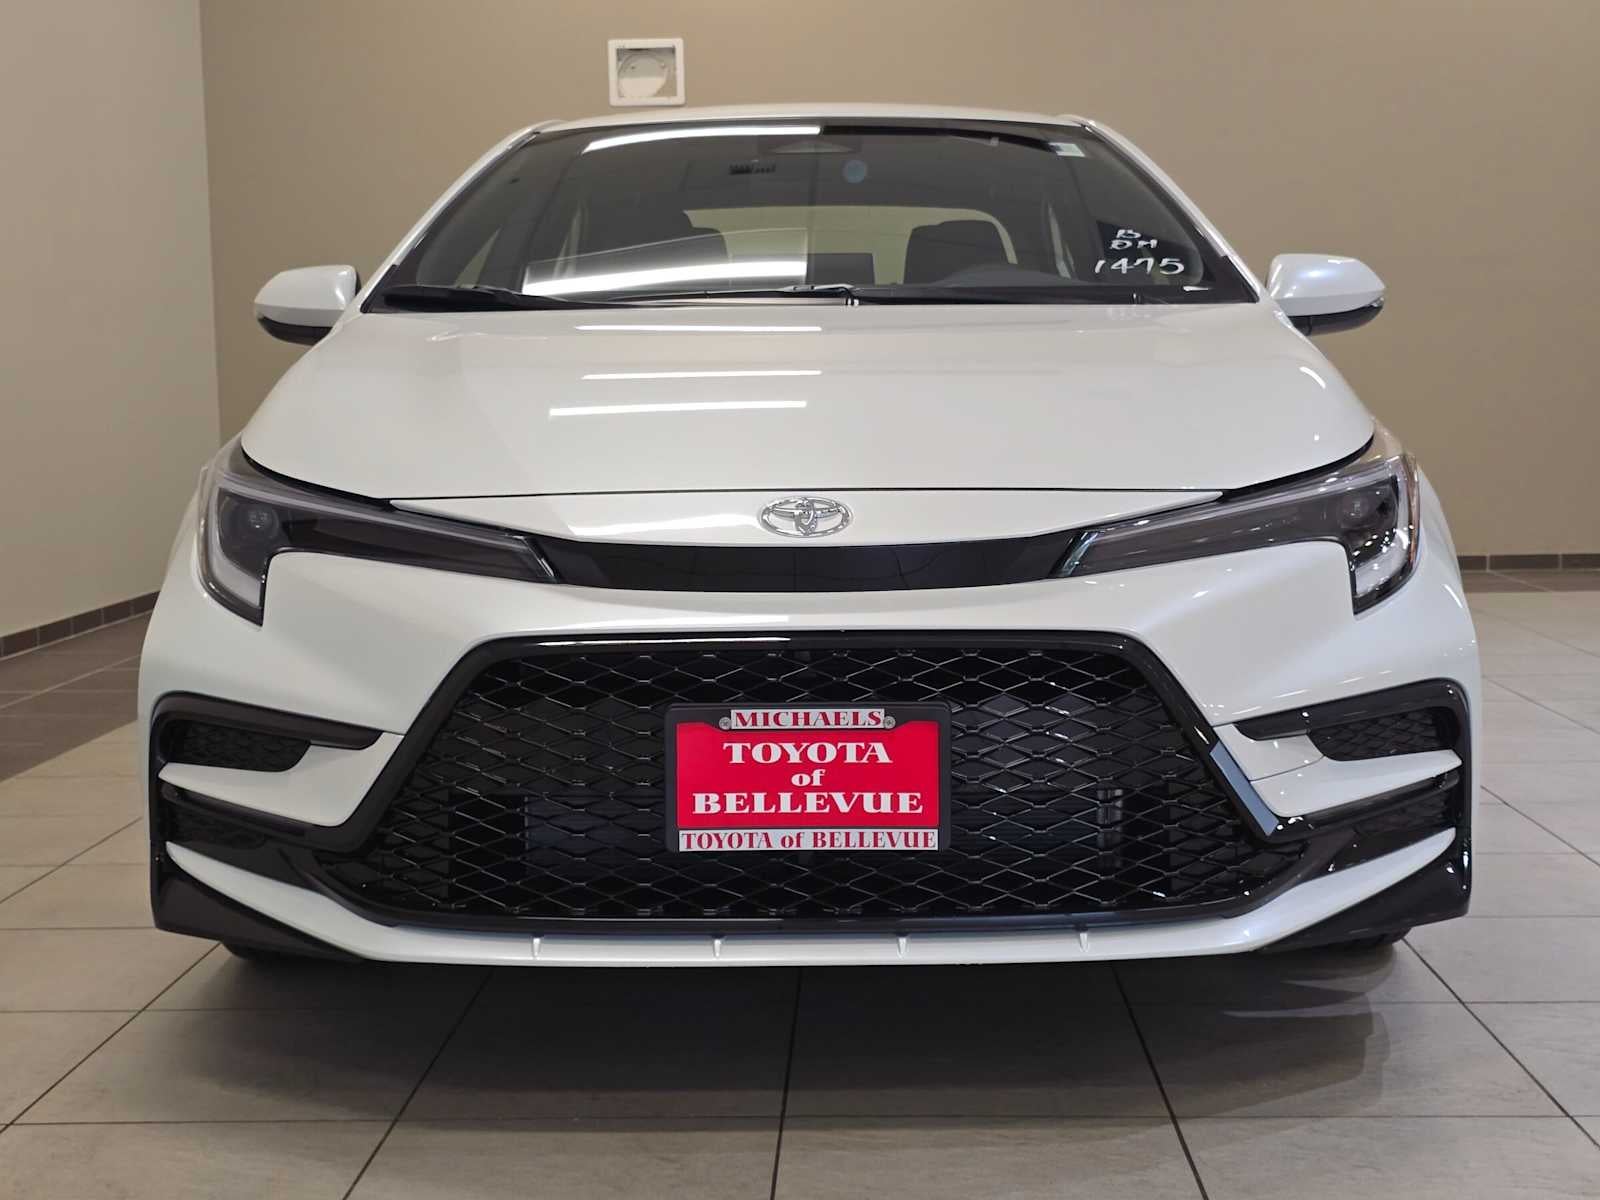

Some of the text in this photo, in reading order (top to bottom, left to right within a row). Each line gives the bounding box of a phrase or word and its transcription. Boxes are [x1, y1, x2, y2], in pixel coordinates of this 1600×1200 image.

[1095, 258, 1184, 275] 1475
[735, 711, 882, 727] MICHAELS
[723, 742, 893, 763] TOYOTA
[791, 768, 826, 787] of
[692, 792, 924, 814] BELLEVUE
[681, 831, 936, 849] TOYOTA of BELLEVUE
